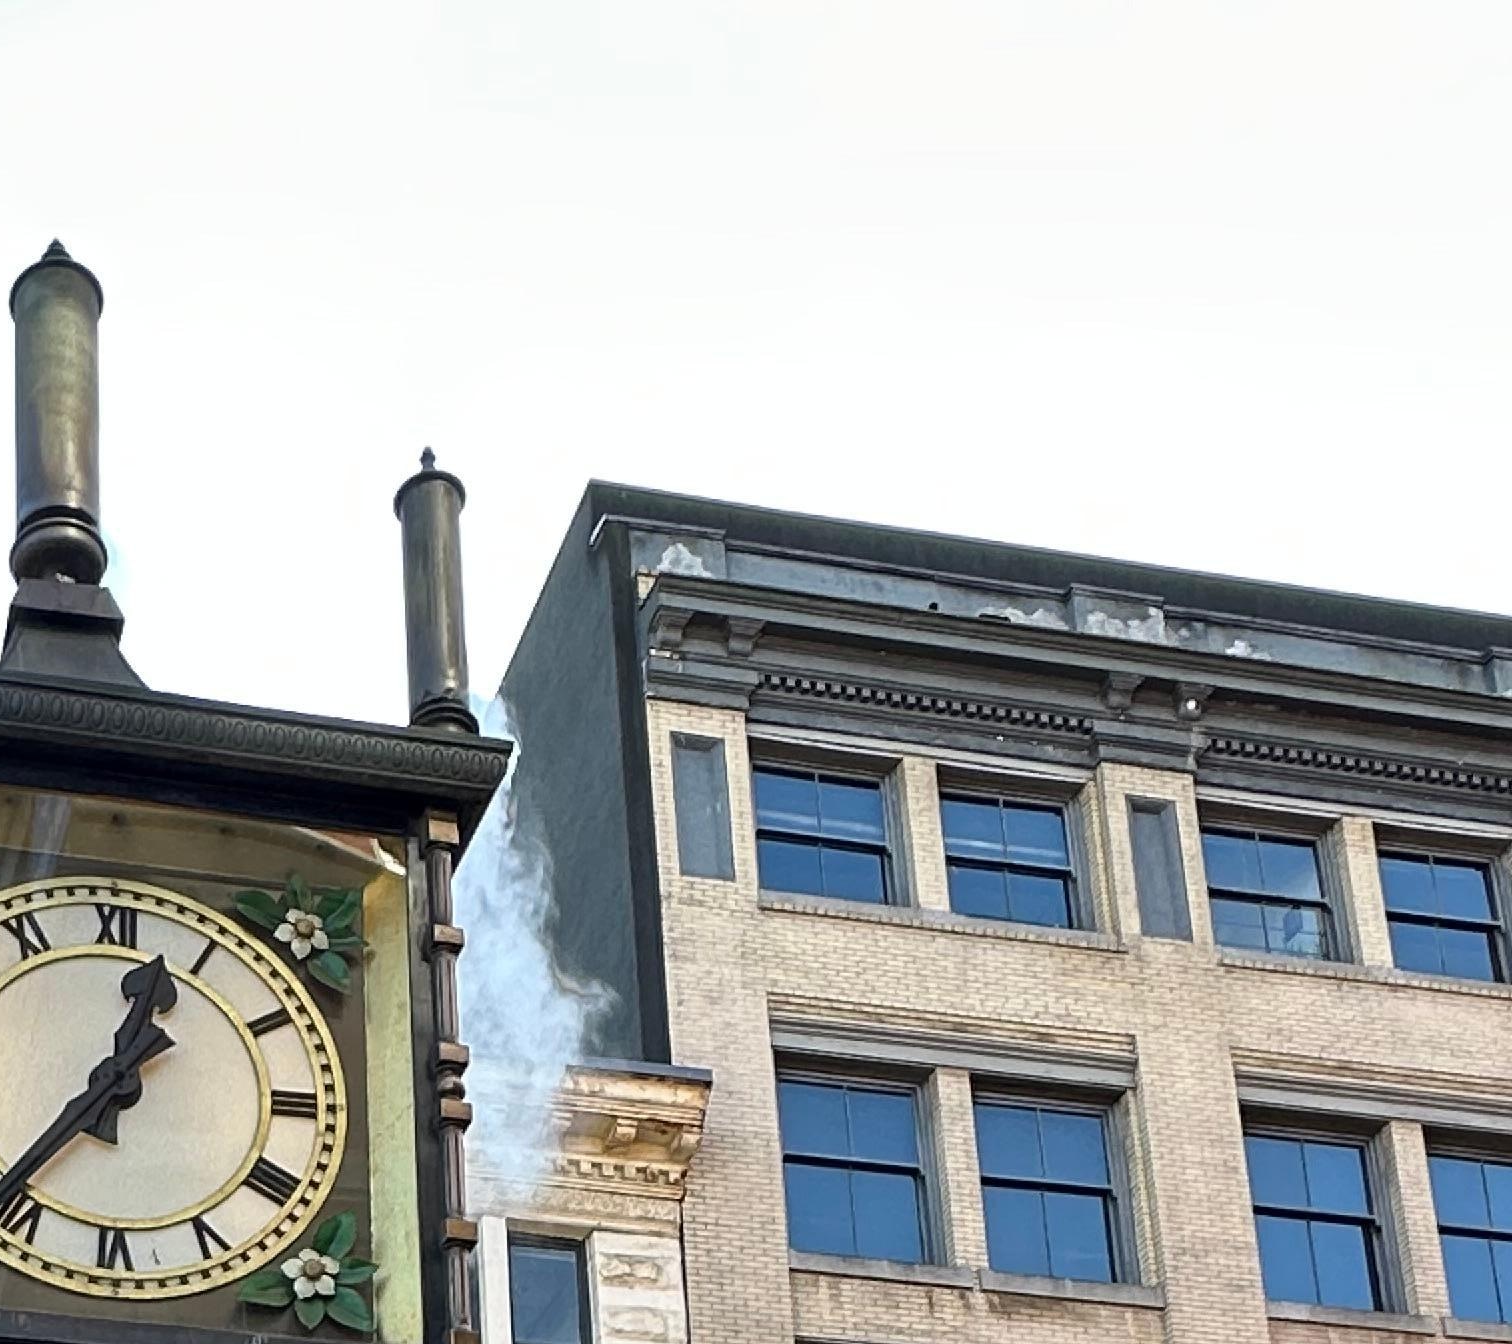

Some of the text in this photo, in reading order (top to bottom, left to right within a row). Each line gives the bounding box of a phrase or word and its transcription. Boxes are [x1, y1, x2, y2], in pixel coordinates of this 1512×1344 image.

[0, 911, 52, 960] XI
[95, 903, 138, 950] XII
[247, 1008, 293, 1038] II
[271, 1089, 317, 1119] III
